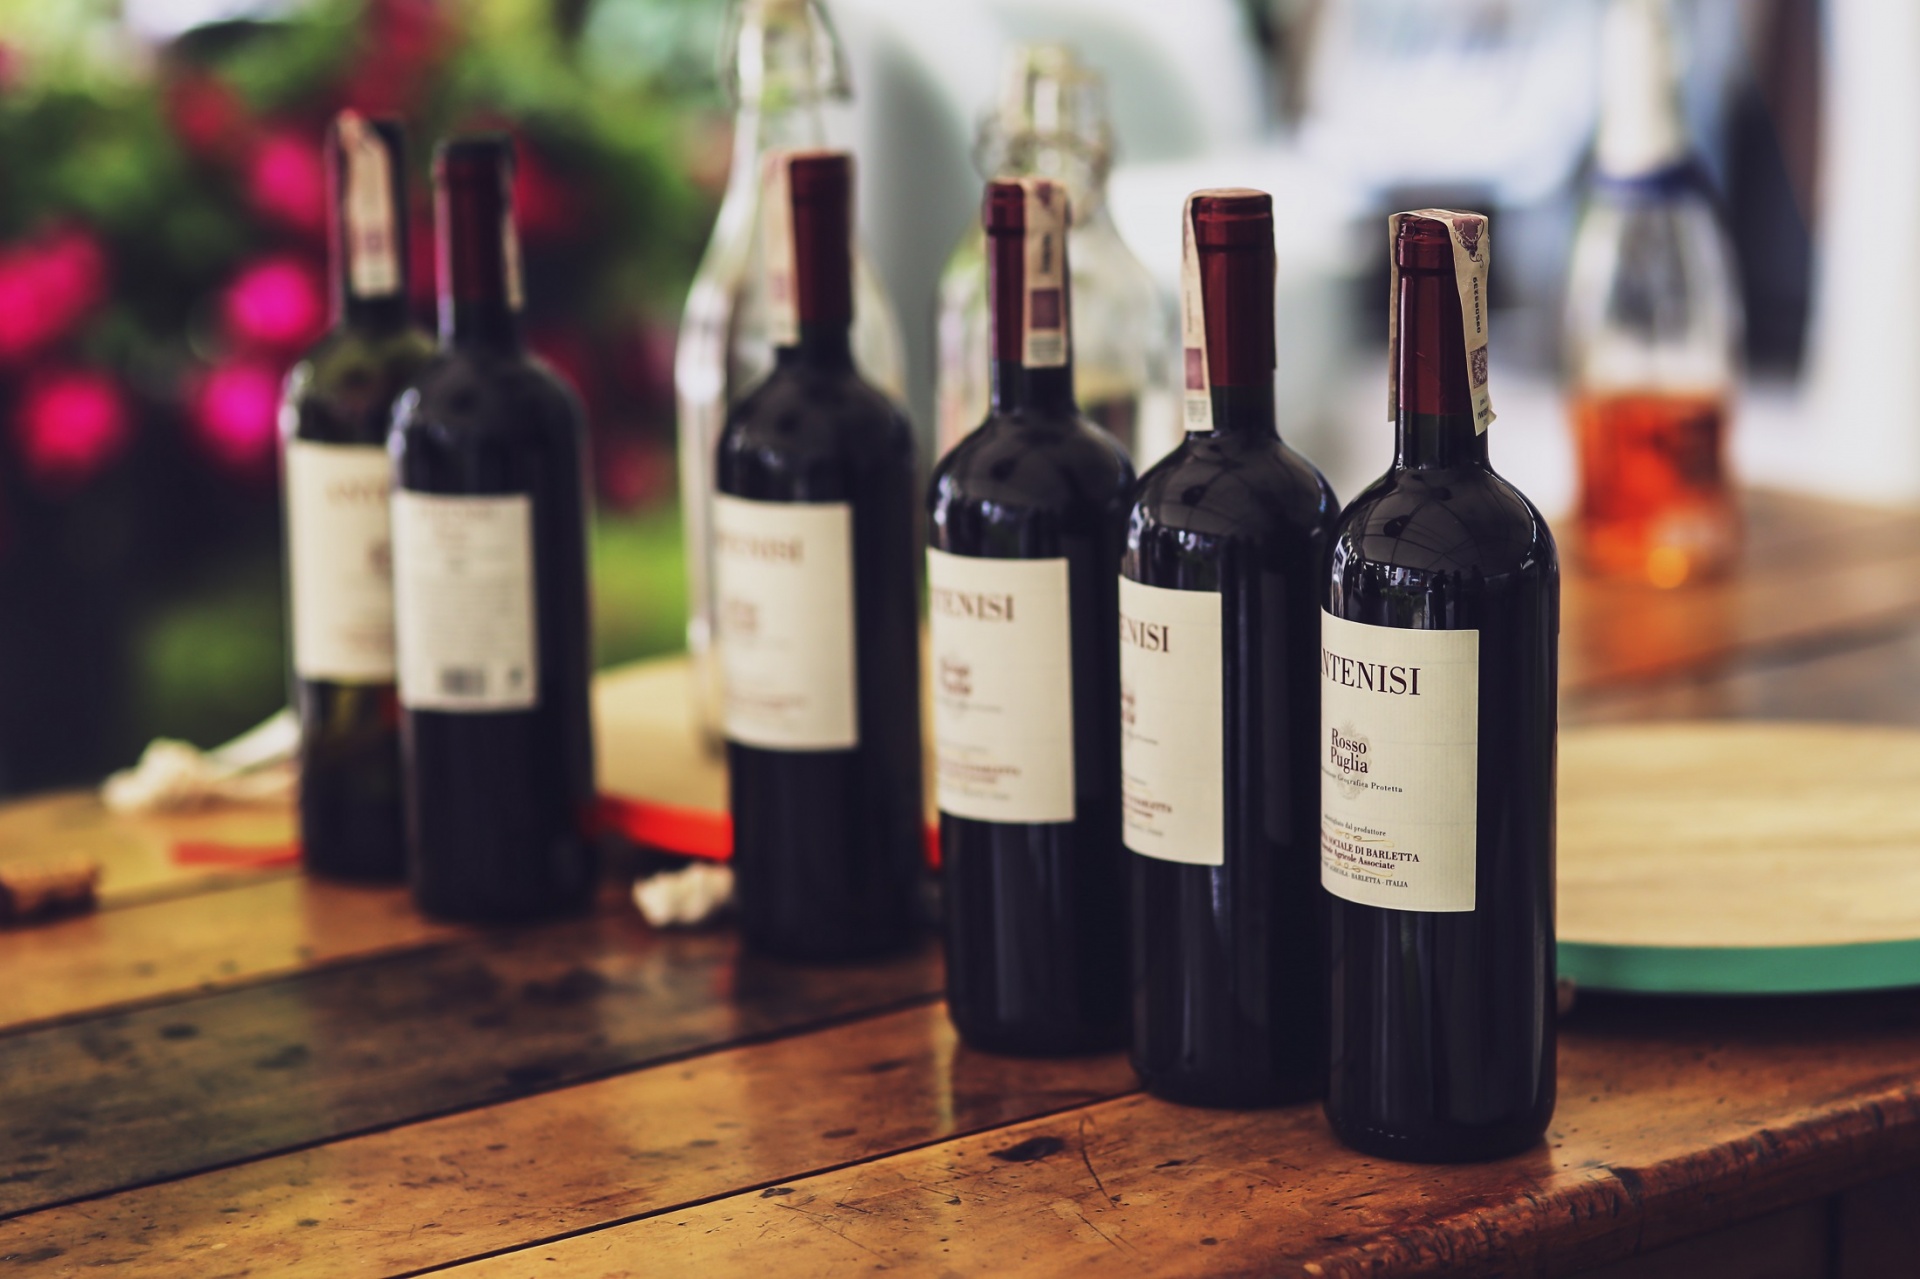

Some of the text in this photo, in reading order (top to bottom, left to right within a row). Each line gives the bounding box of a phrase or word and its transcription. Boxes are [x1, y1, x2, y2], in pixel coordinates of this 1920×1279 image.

[1331, 727, 1367, 754] Rosso
[1330, 745, 1368, 774] Puglia
[1371, 781, 1403, 793] Protetta
[1355, 845, 1364, 856] DI
[1366, 847, 1420, 863] BARLETTA
[1358, 856, 1396, 871] Associate
[1351, 872, 1381, 885] BARLETTA
[1385, 879, 1409, 889] ITALIA
